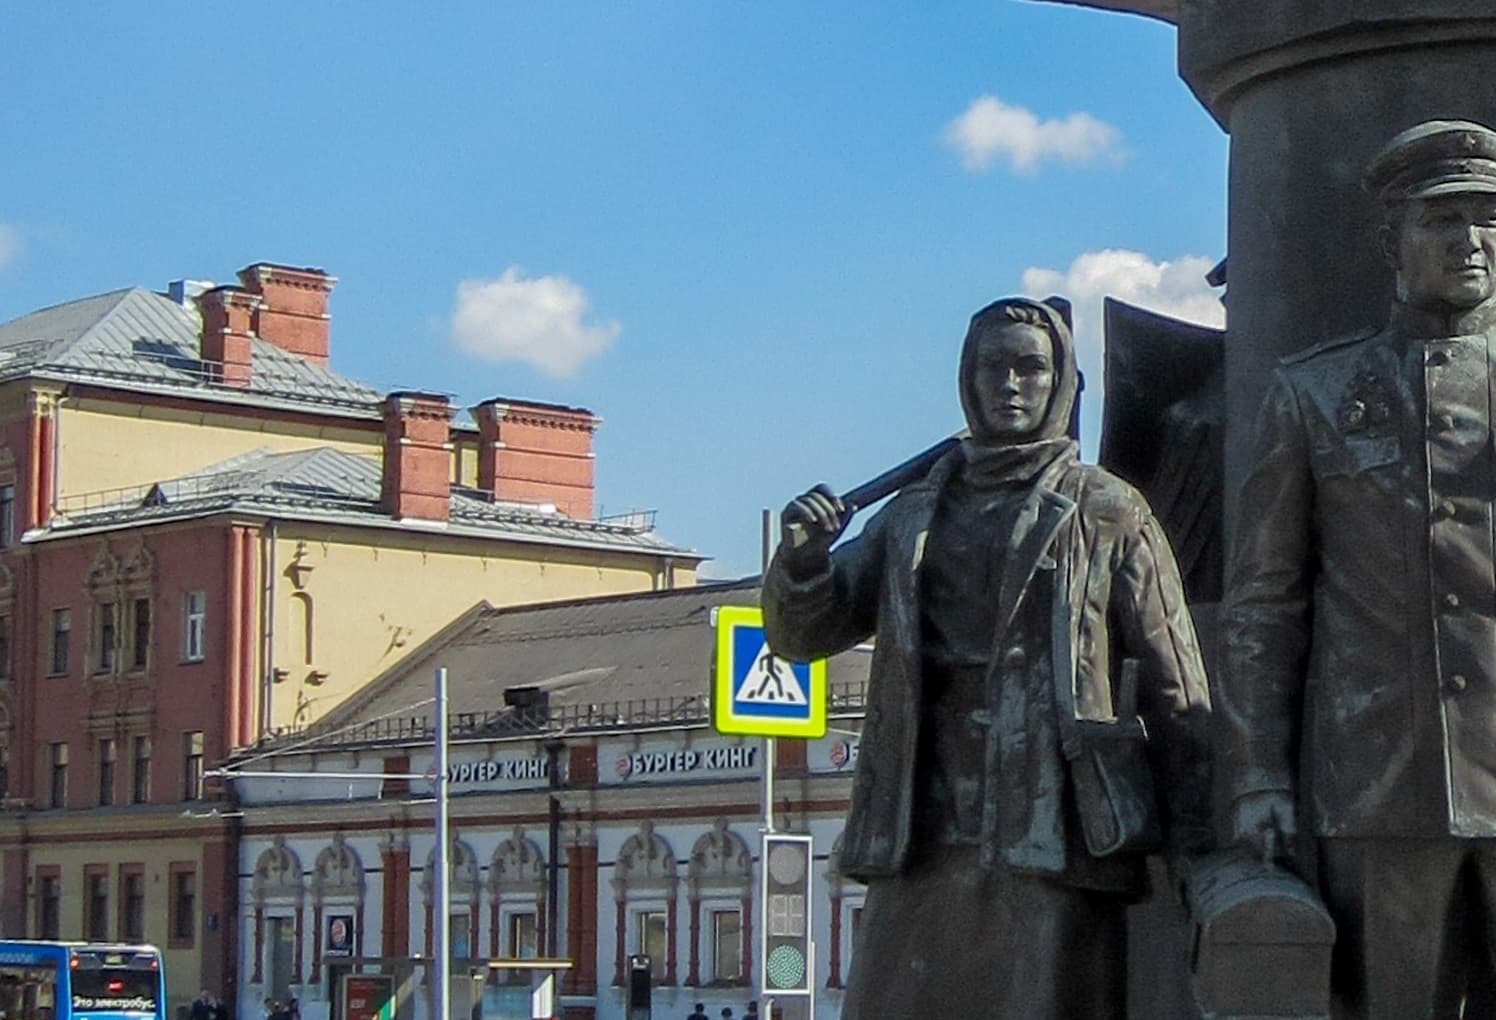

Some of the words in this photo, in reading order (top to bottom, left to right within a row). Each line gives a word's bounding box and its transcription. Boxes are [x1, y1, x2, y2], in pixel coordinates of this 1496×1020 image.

[448, 761, 498, 782] УРГЕР
[504, 758, 549, 779] КИНГ
[632, 752, 697, 774] БУРГЕР
[703, 748, 756, 769] КИНГ
[73, 996, 93, 1007] Это
